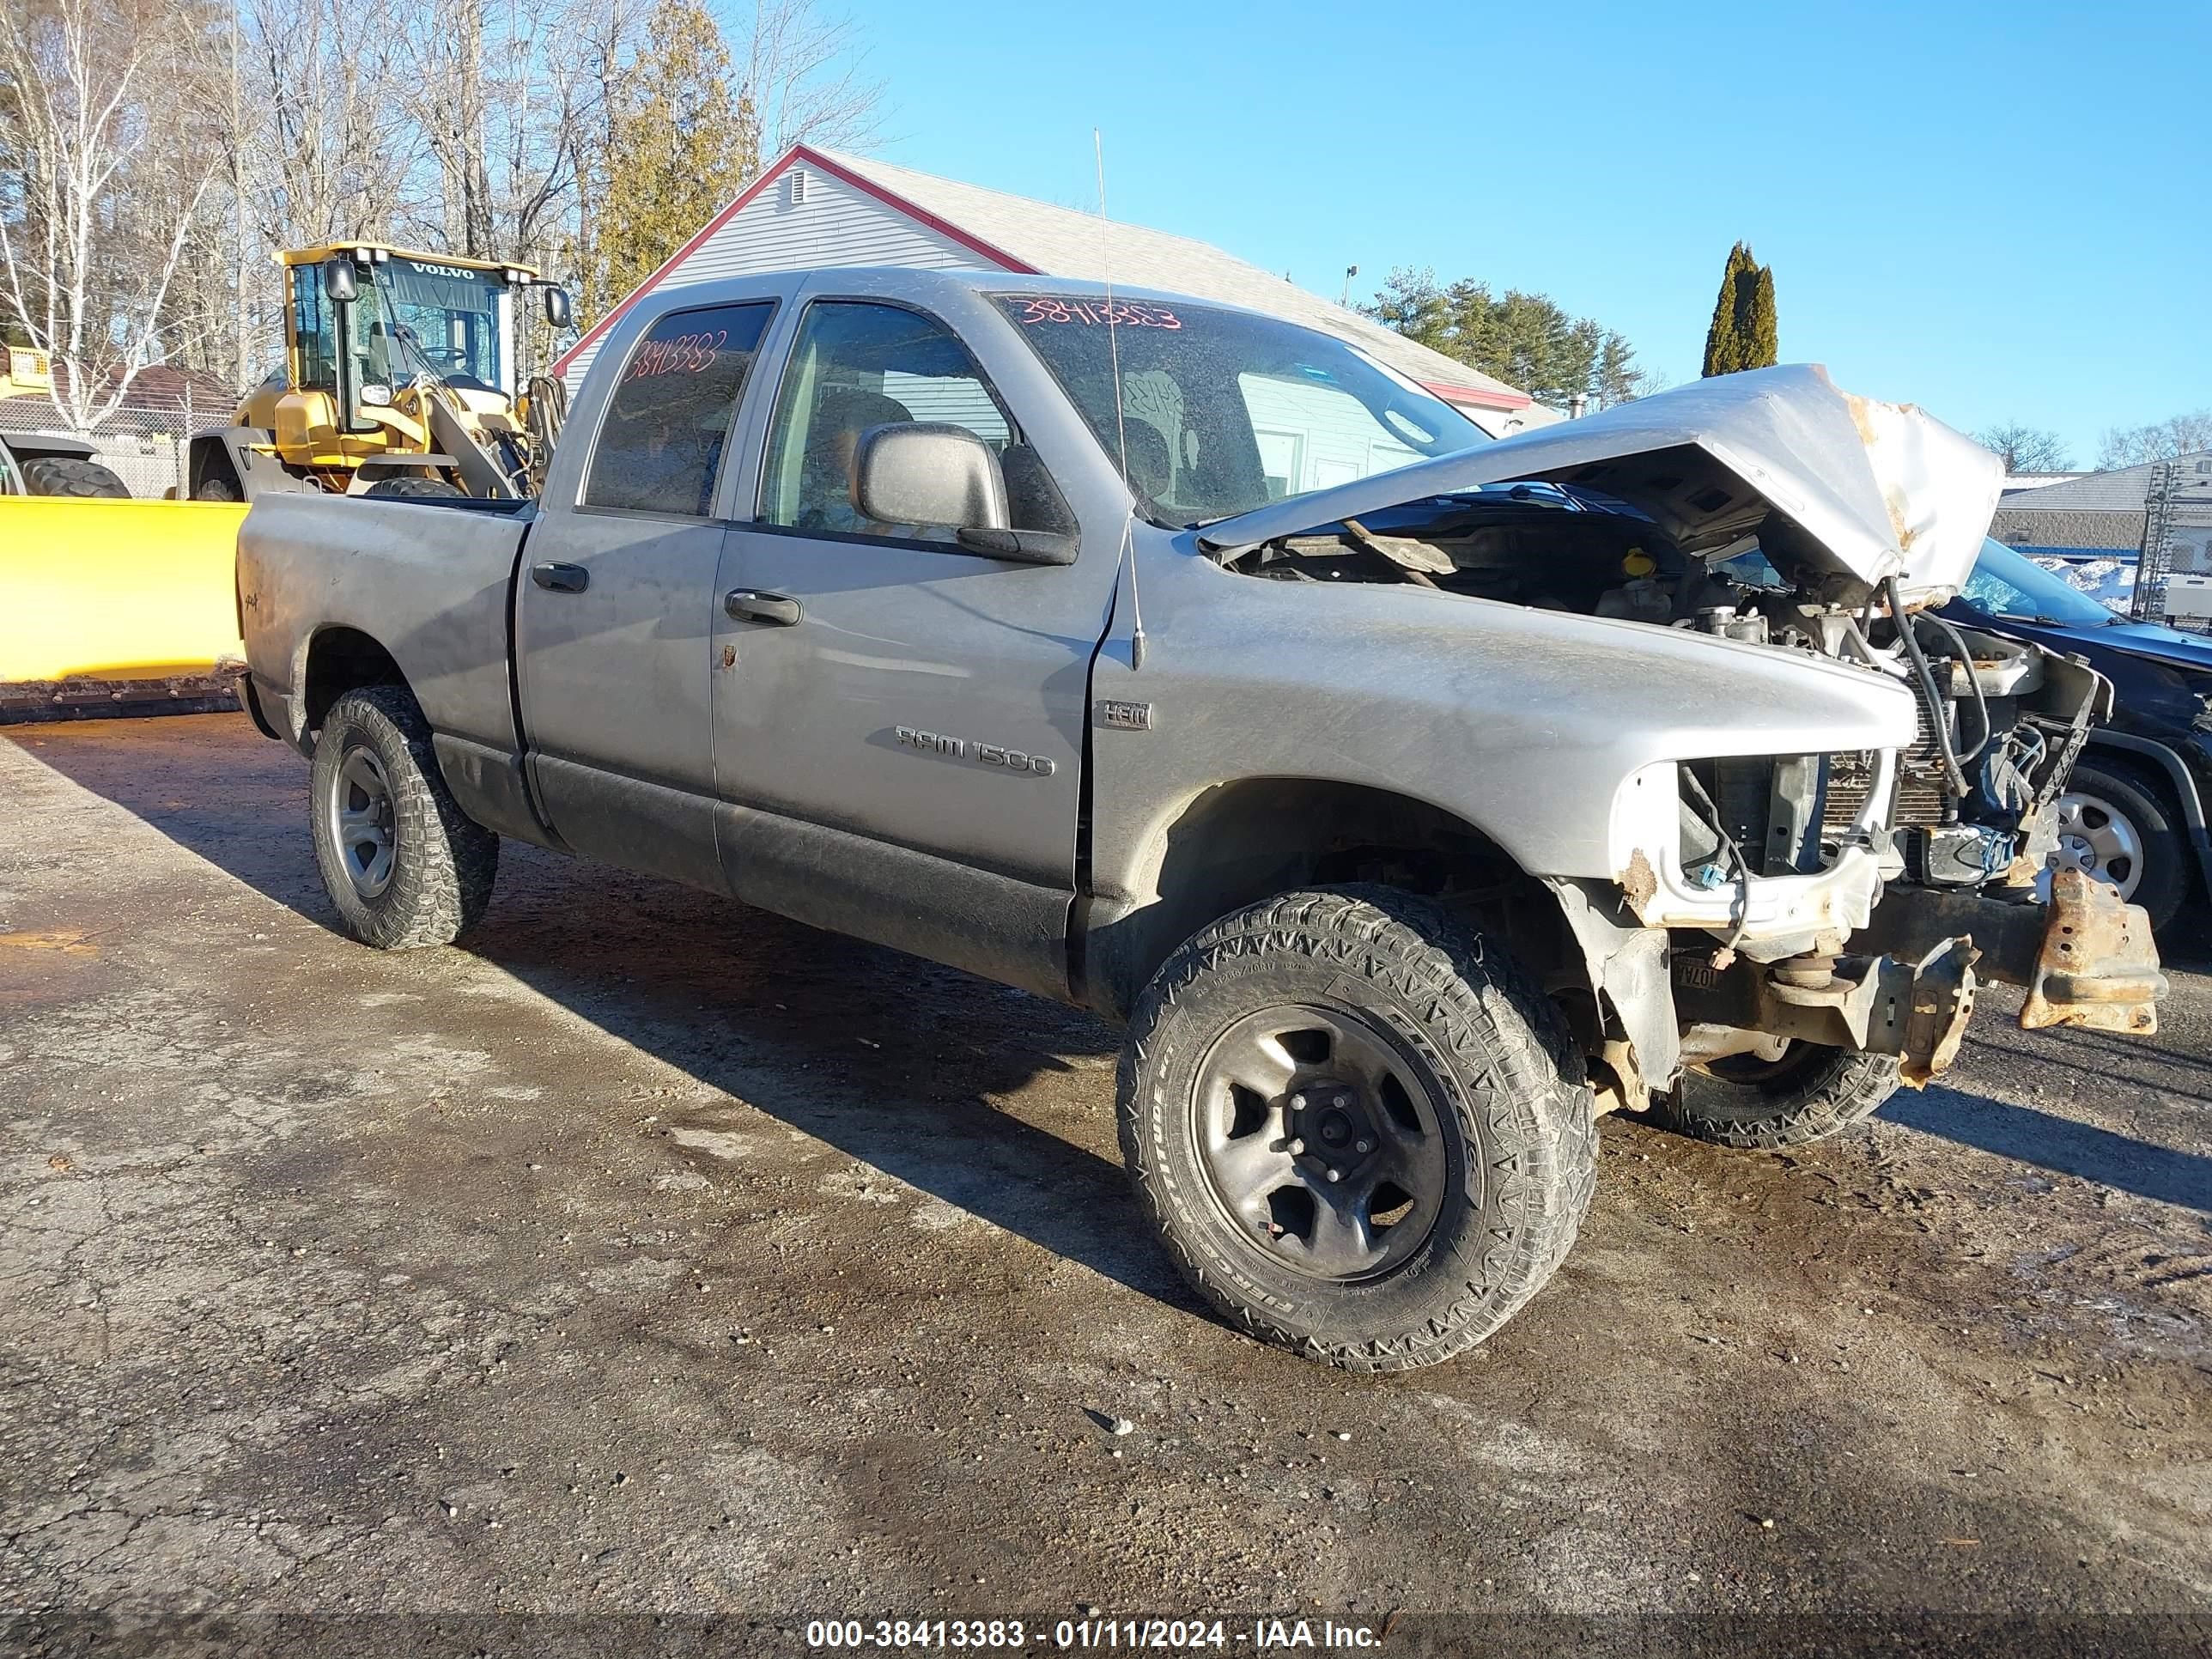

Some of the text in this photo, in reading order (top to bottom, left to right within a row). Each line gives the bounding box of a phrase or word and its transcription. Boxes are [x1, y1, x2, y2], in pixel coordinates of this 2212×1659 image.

[409, 261, 475, 280] VOLVO
[623, 330, 727, 383] 38413383
[895, 725, 1056, 776] RAM 1500
[1152, 1084, 1194, 1224] ATTITUDE
[1198, 1241, 1294, 1314] FIERCE
